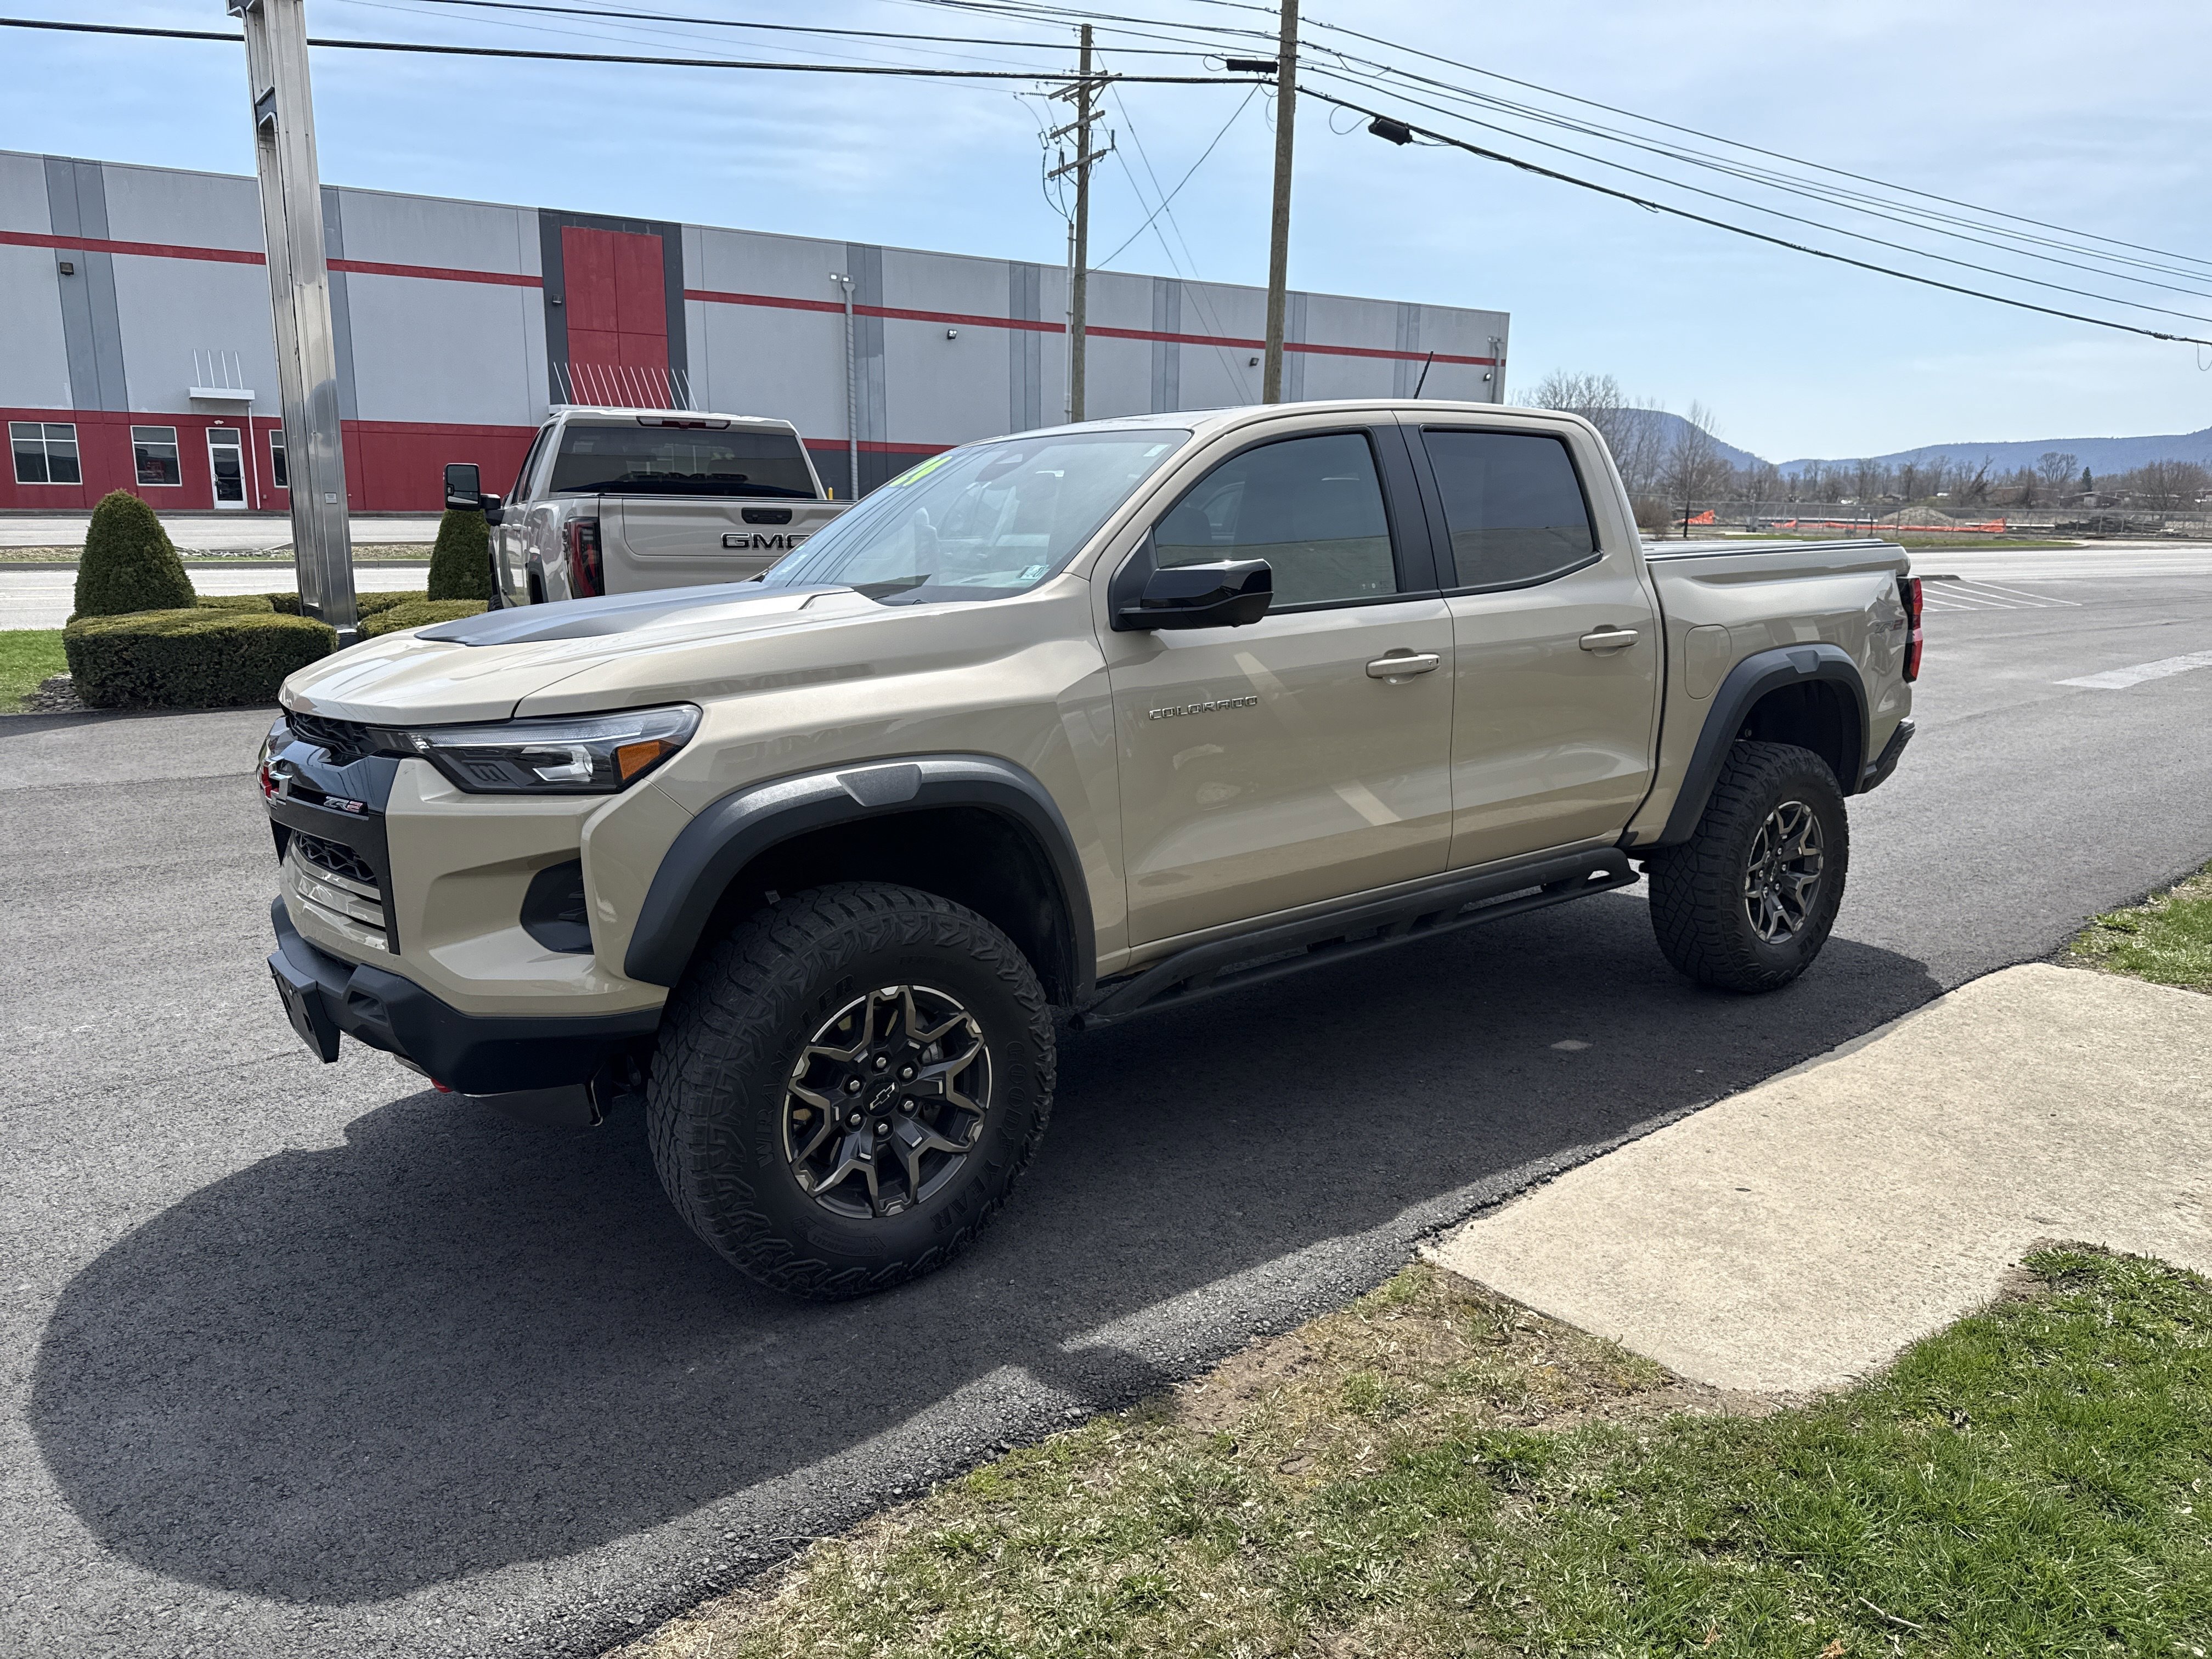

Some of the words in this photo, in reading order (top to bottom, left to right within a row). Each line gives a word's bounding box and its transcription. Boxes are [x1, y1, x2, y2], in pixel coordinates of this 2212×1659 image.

[721, 533, 812, 549] GMC
[1875, 619, 1903, 634] ZR2
[1149, 696, 1257, 720] COLORADO
[324, 796, 363, 812] ZR2
[755, 974, 855, 1168] WRANGLER
